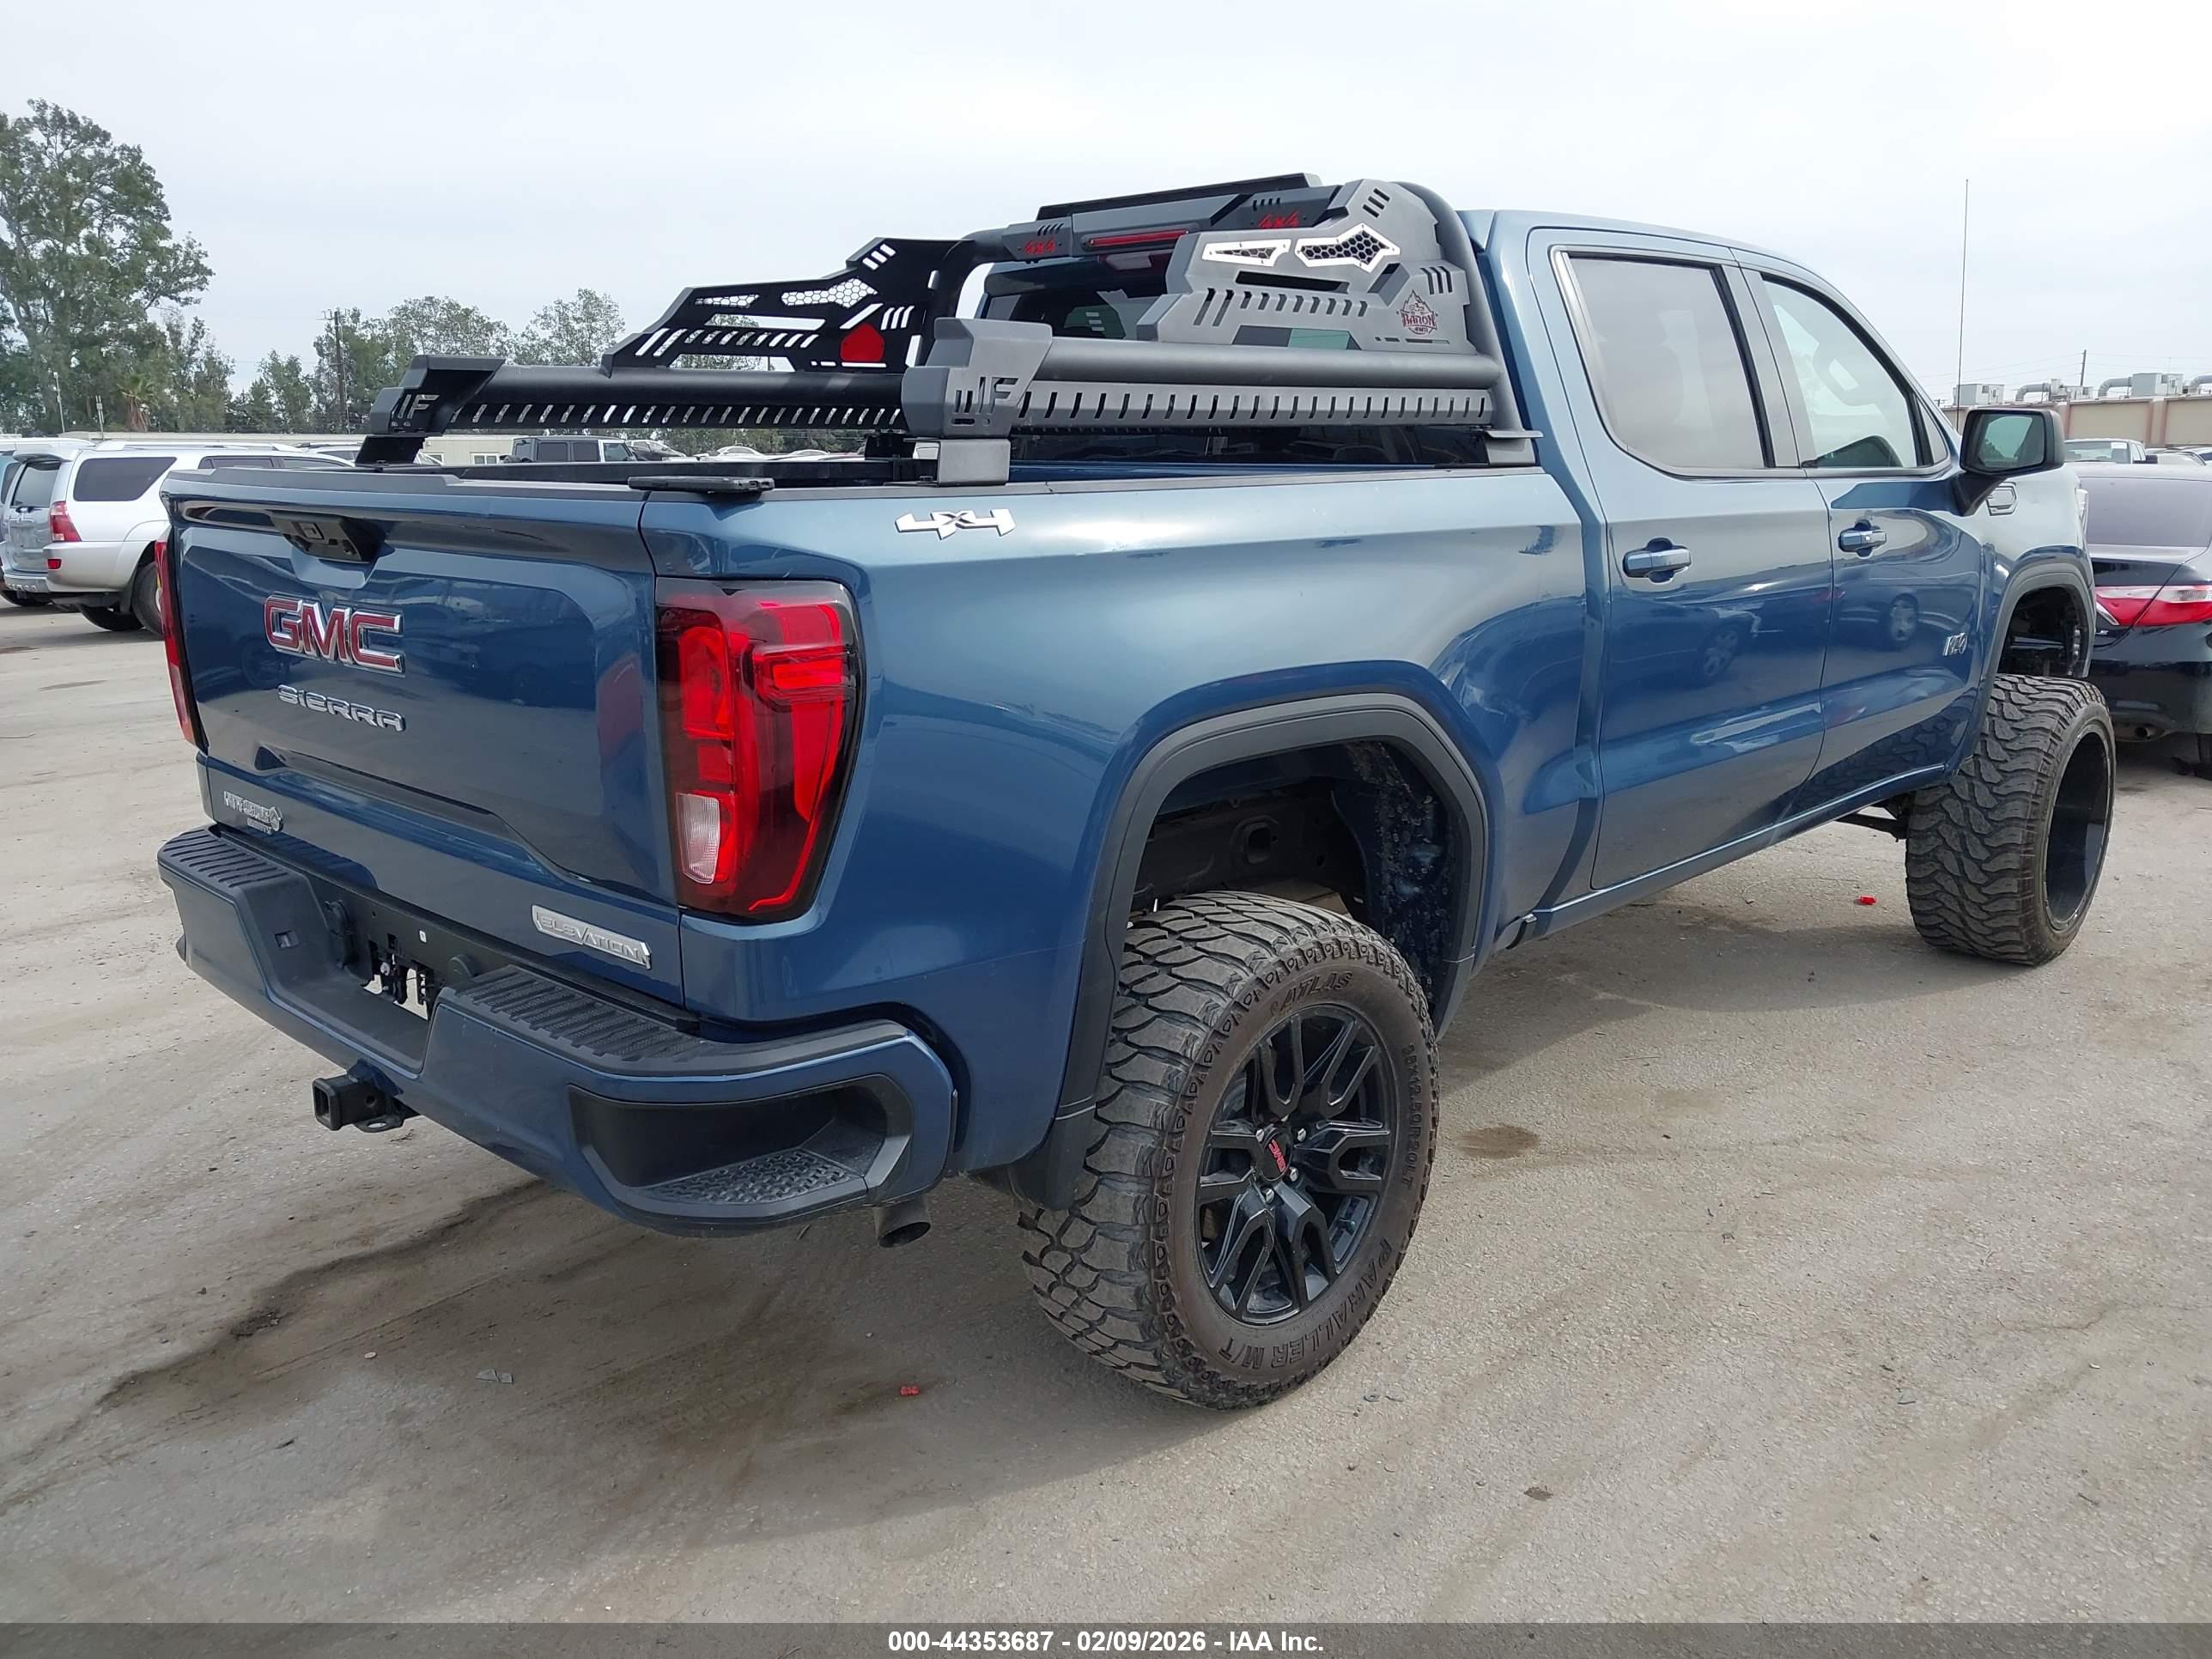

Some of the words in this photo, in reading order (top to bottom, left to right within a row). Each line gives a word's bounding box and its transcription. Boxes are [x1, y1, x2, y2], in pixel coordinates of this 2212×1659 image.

[264, 592, 406, 676] GMC
[277, 684, 406, 732] SIERRA
[540, 915, 640, 960] ELEVATION
[1279, 971, 1353, 1012] ATLAS
[1268, 1139, 1286, 1173] GMC
[1218, 1336, 1266, 1370] M/T
